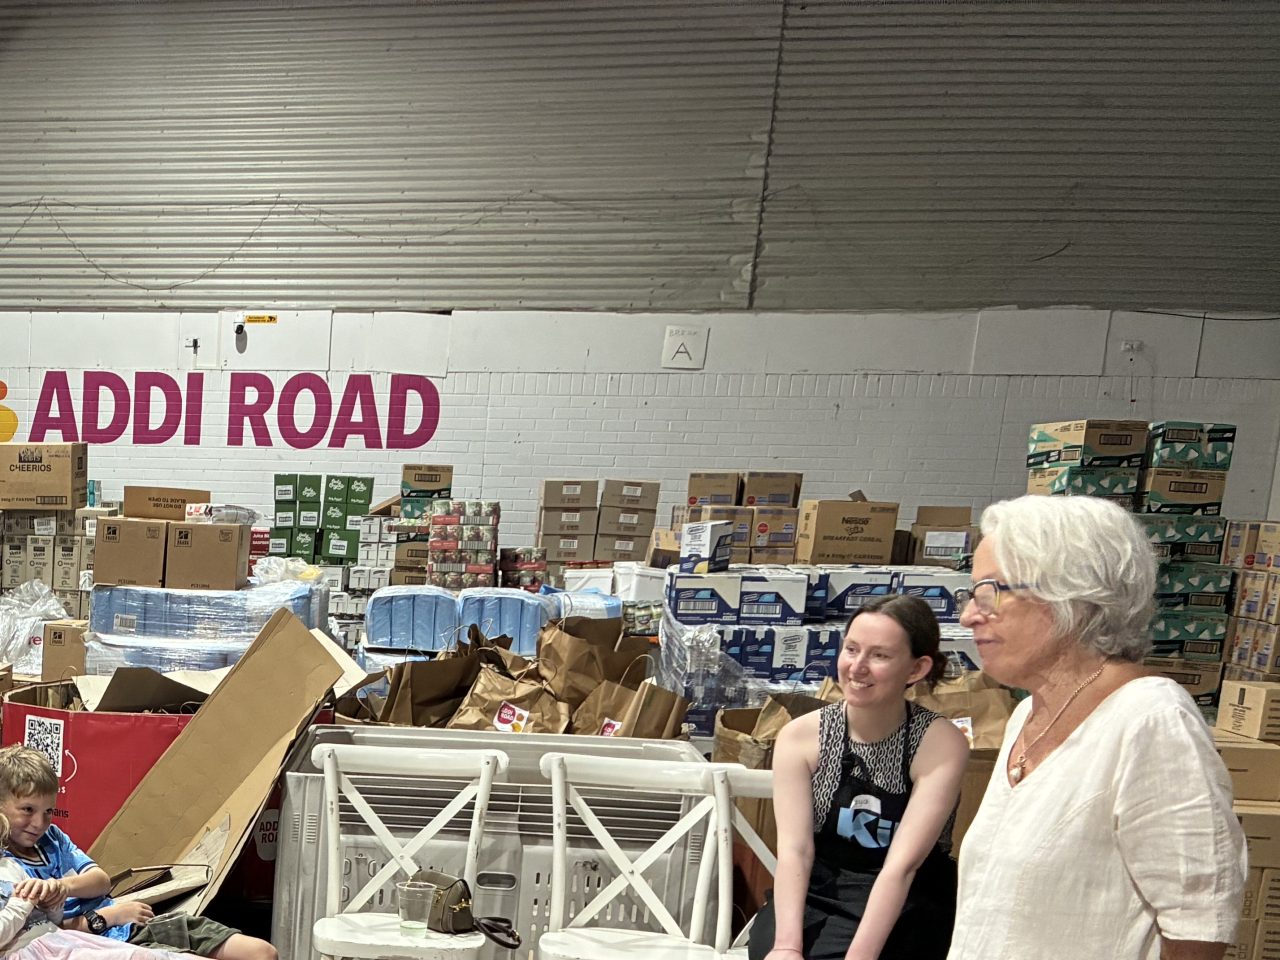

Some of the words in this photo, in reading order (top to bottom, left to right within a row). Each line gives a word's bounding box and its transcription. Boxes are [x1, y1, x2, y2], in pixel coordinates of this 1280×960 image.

[28, 370, 205, 446] ADDI
[227, 372, 441, 450] ROAD
[9, 464, 52, 472] CHEERIOS
[259, 820, 279, 832] ADD
